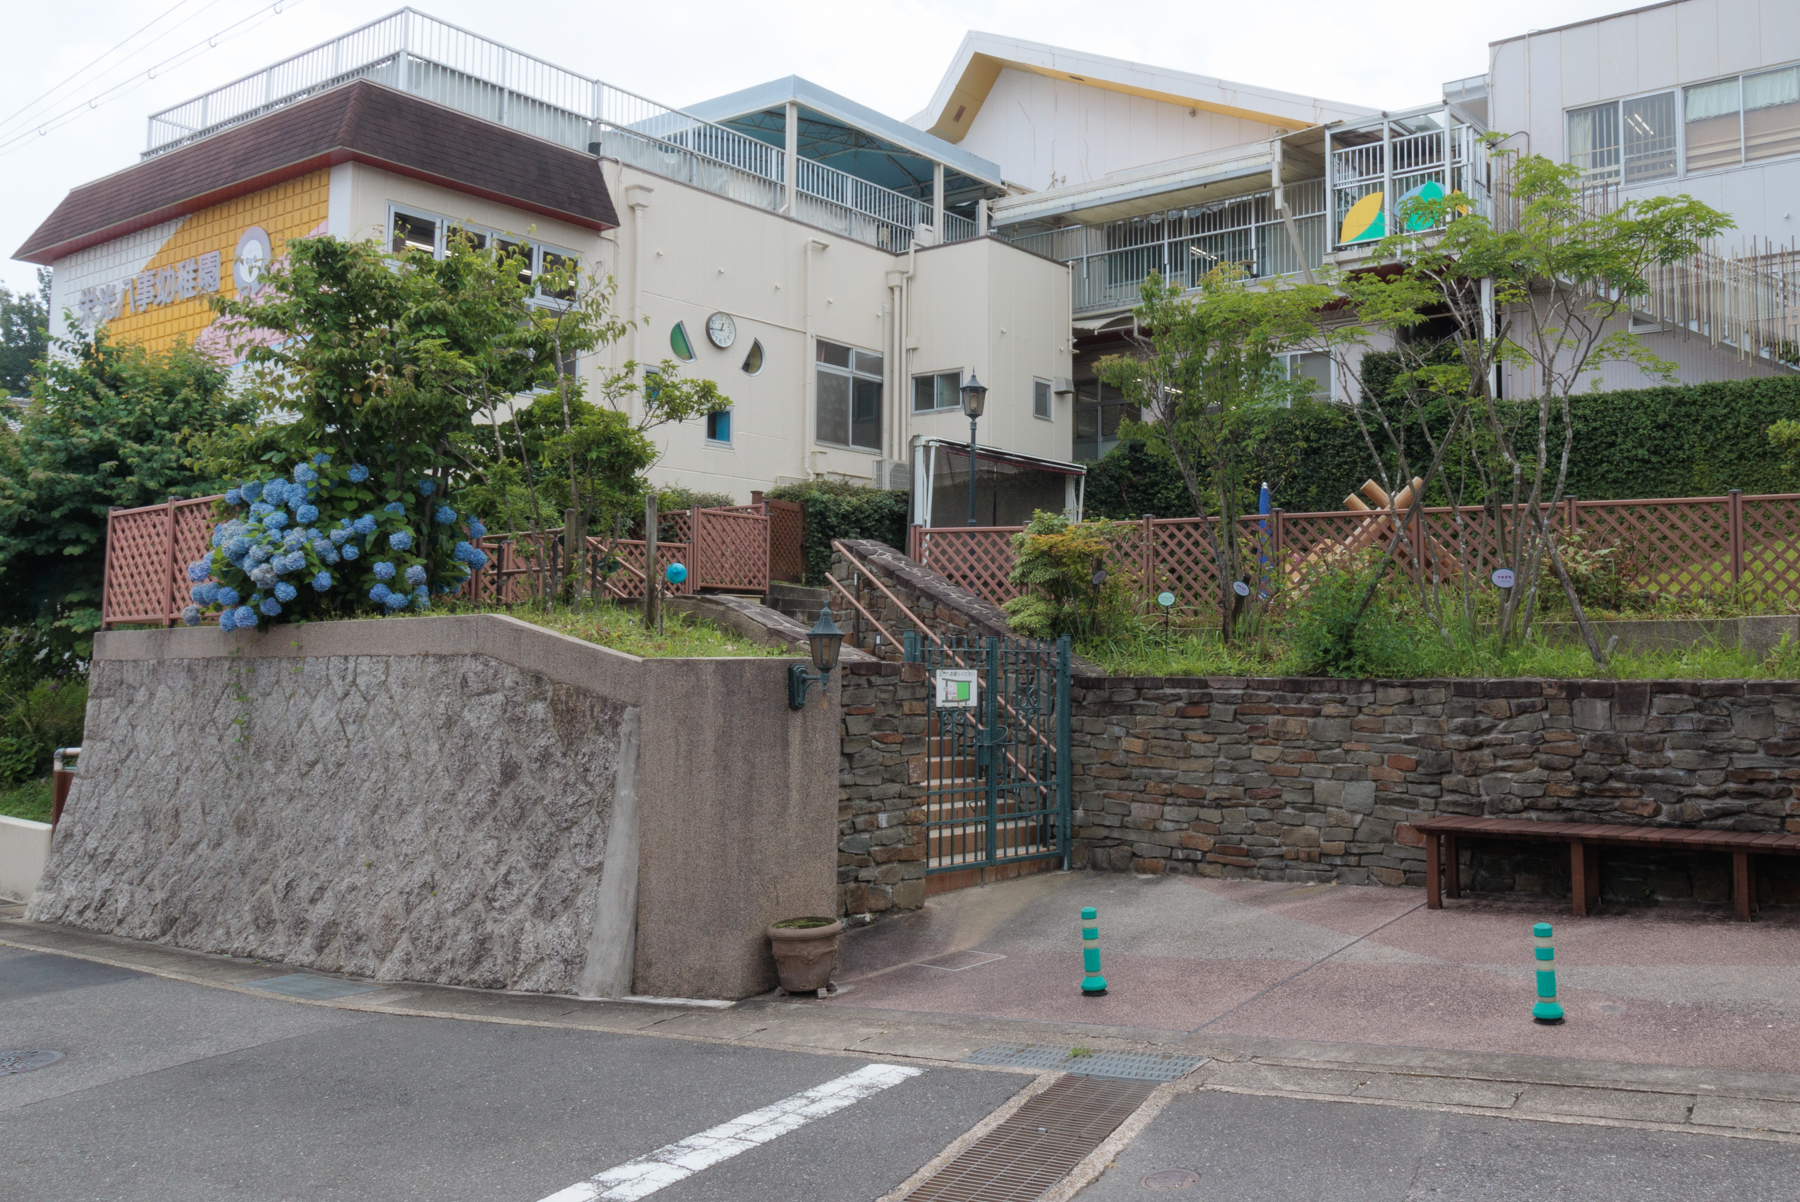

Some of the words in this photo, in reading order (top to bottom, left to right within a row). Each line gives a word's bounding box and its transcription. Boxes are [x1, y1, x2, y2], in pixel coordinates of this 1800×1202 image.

[78, 250, 222, 328] 栄光八事幼稚園
